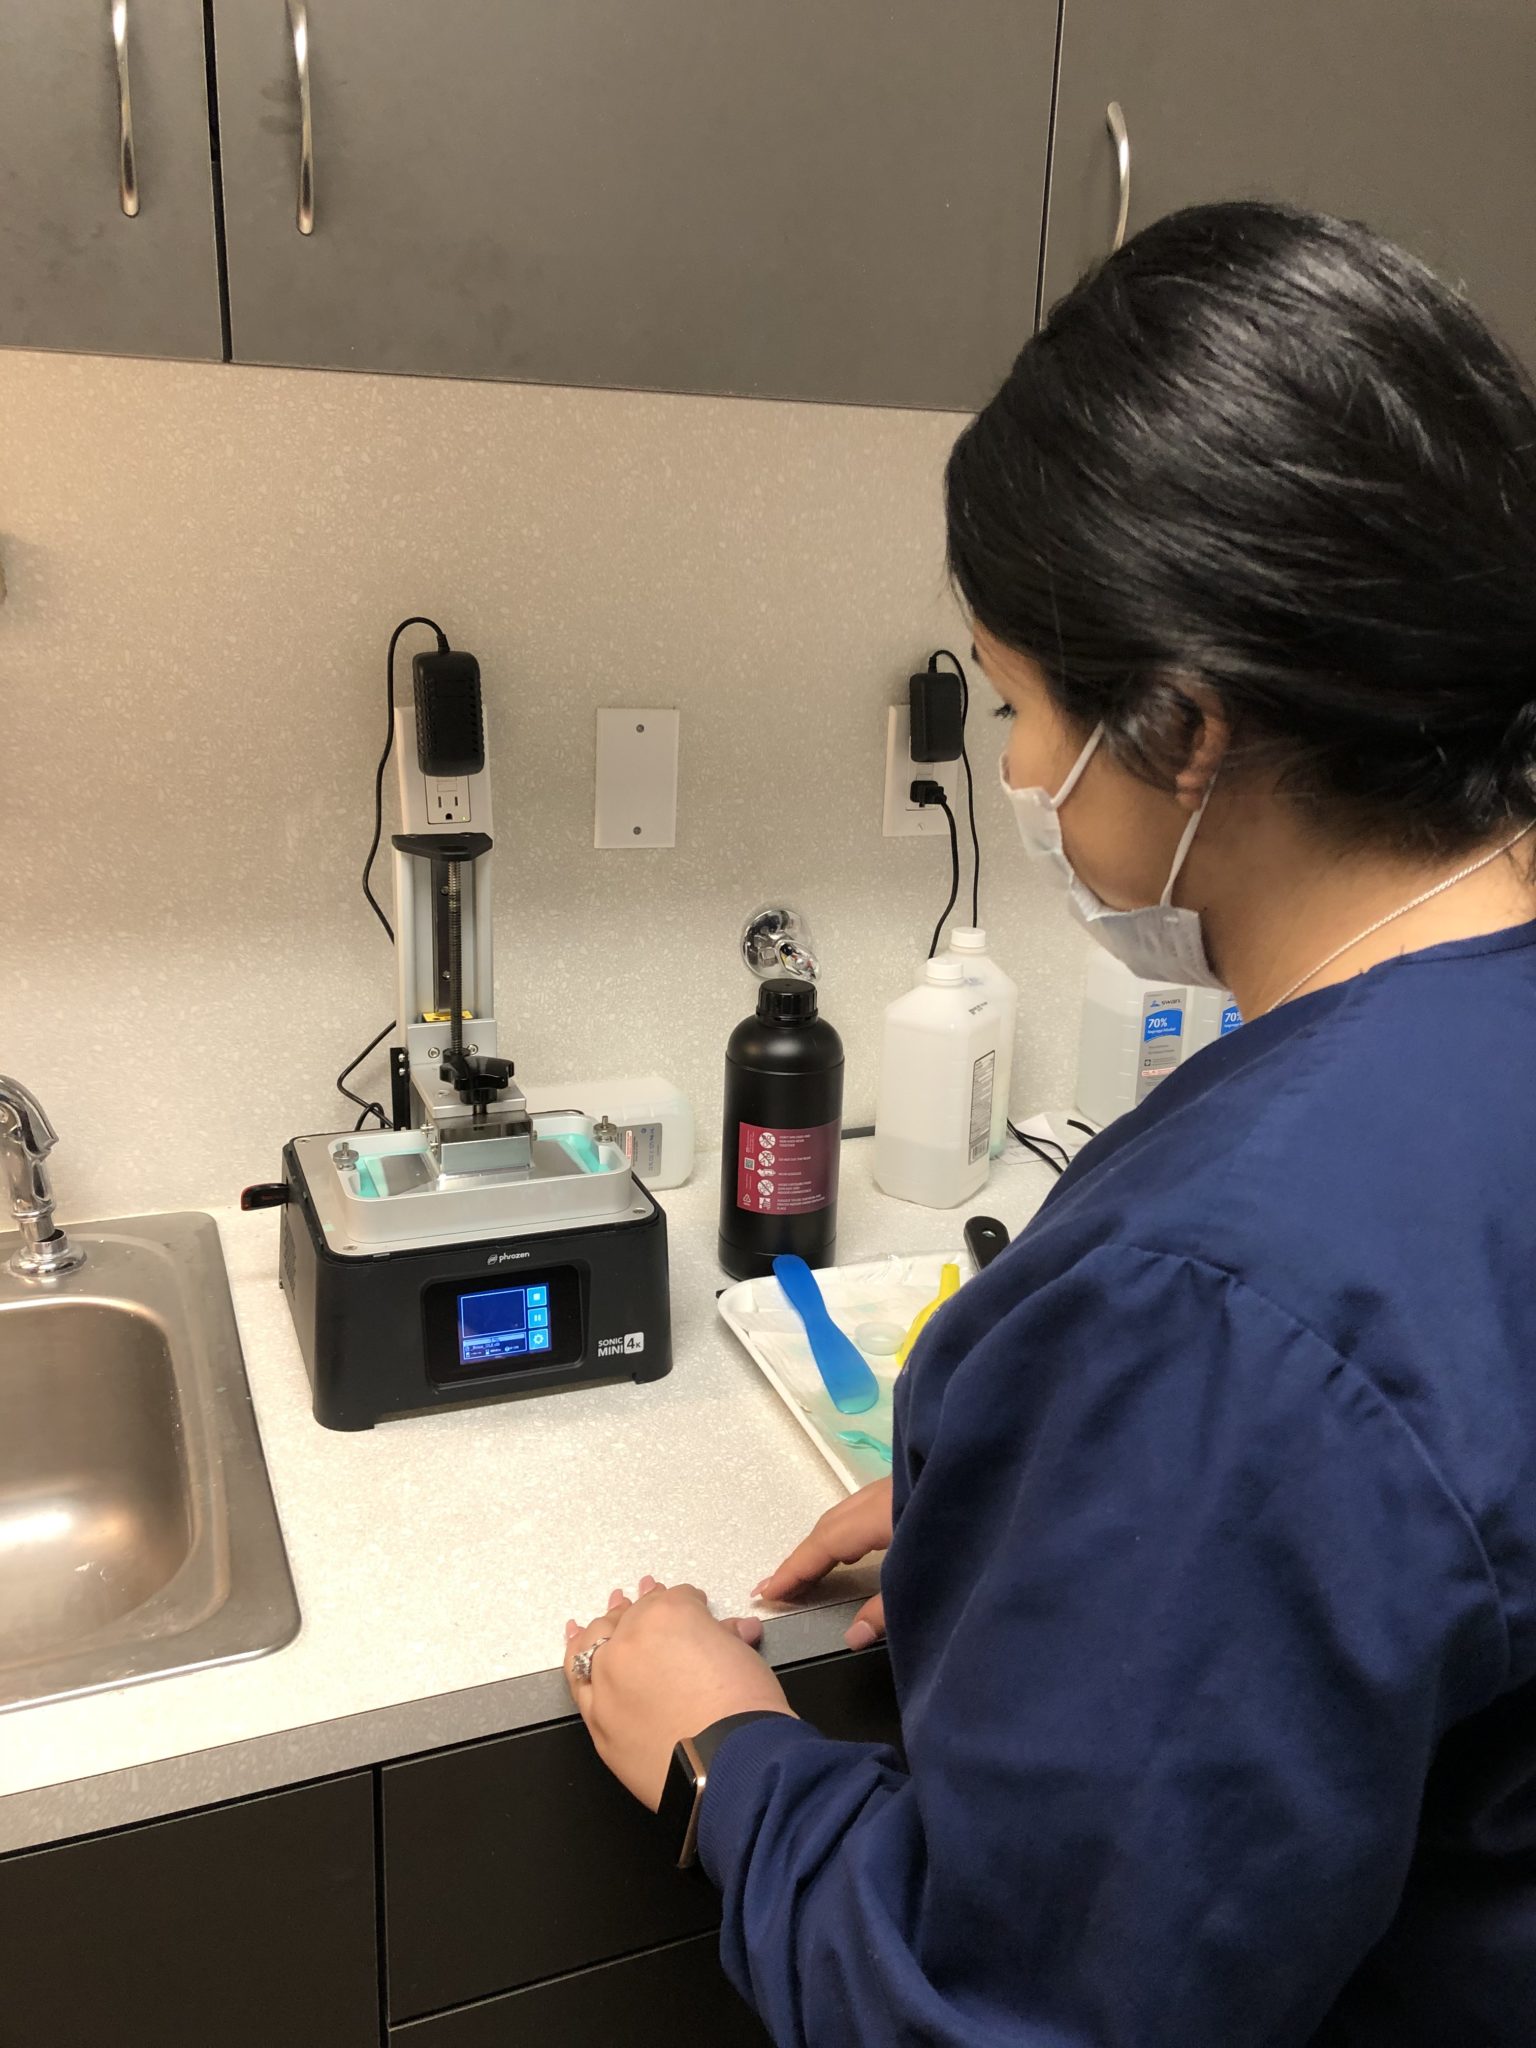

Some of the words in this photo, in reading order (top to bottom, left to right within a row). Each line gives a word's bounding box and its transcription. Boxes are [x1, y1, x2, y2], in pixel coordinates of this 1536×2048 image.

[1148, 1016, 1168, 1029] 70%
[498, 1252, 530, 1264] phrozen
[597, 1336, 624, 1348] SONIC
[597, 1344, 624, 1357] MINI
